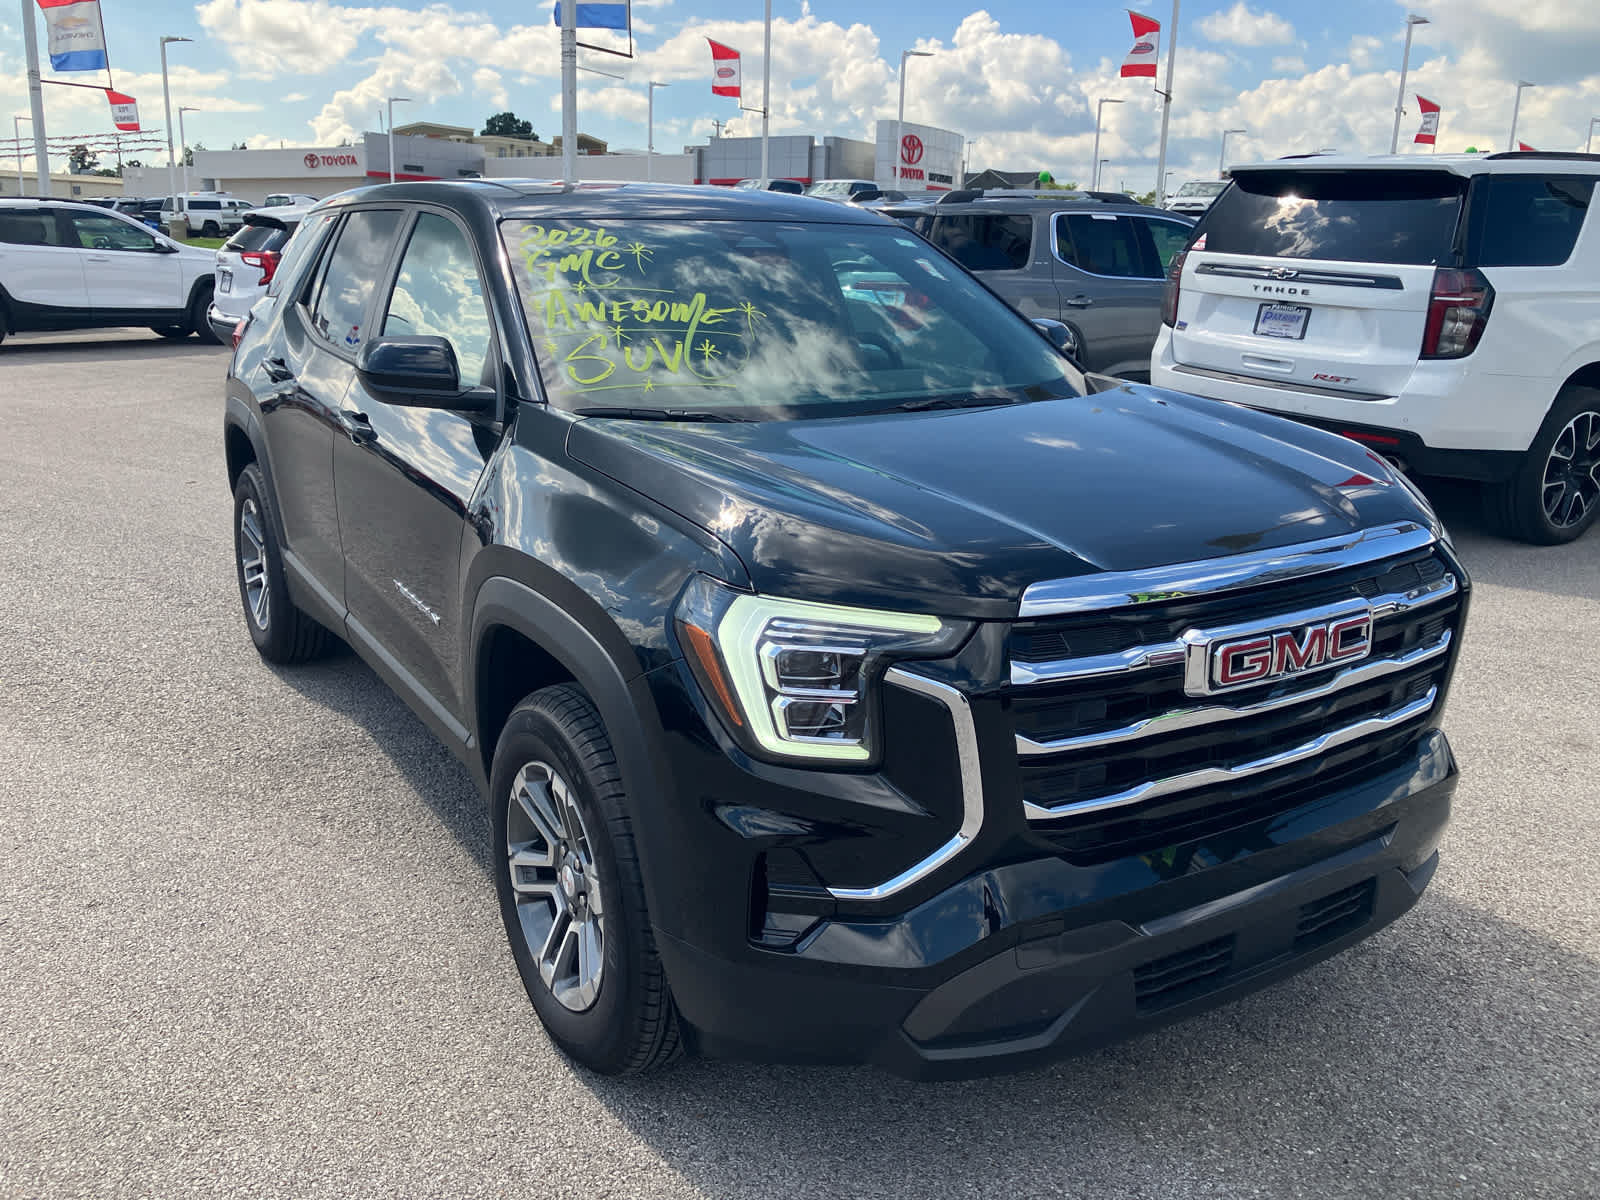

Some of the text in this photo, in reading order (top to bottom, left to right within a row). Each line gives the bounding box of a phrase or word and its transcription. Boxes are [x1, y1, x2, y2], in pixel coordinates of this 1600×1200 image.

[320, 155, 358, 166] TOYOTA
[891, 166, 925, 181] TOYOTA
[520, 225, 618, 248] 2026
[526, 249, 626, 287] GMC
[1253, 284, 1311, 296] TAHOE
[565, 333, 684, 384] SUV
[1312, 373, 1359, 385] RST
[1213, 612, 1372, 686] GMC
